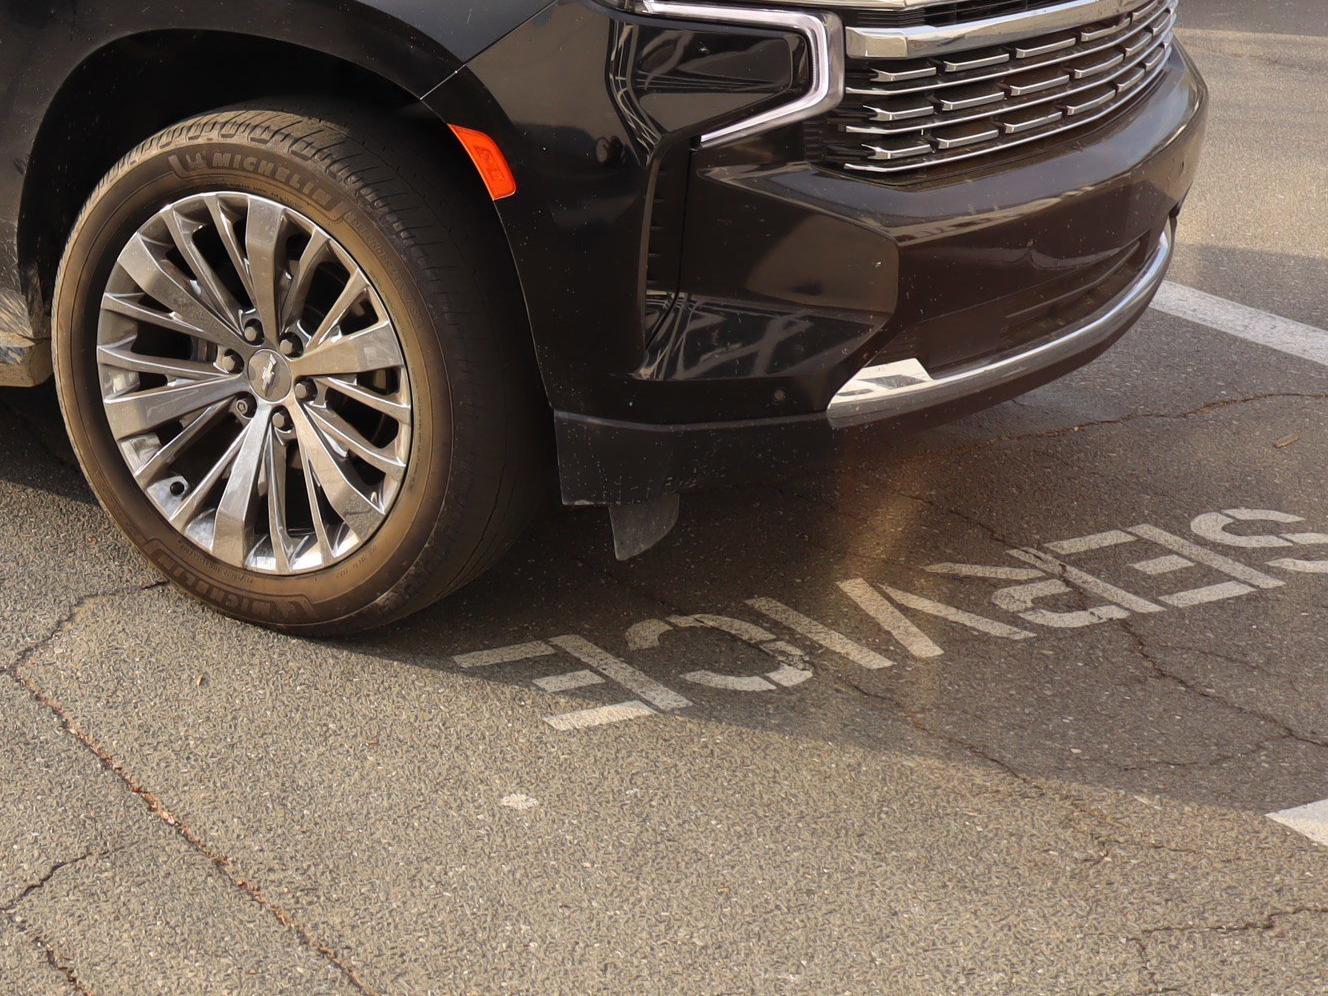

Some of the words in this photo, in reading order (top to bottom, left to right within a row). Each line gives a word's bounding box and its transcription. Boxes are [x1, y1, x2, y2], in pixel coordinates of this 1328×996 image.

[212, 152, 333, 208] MICHELIN
[157, 547, 271, 617] MICHELIN
[454, 508, 1328, 731] SERVICE
